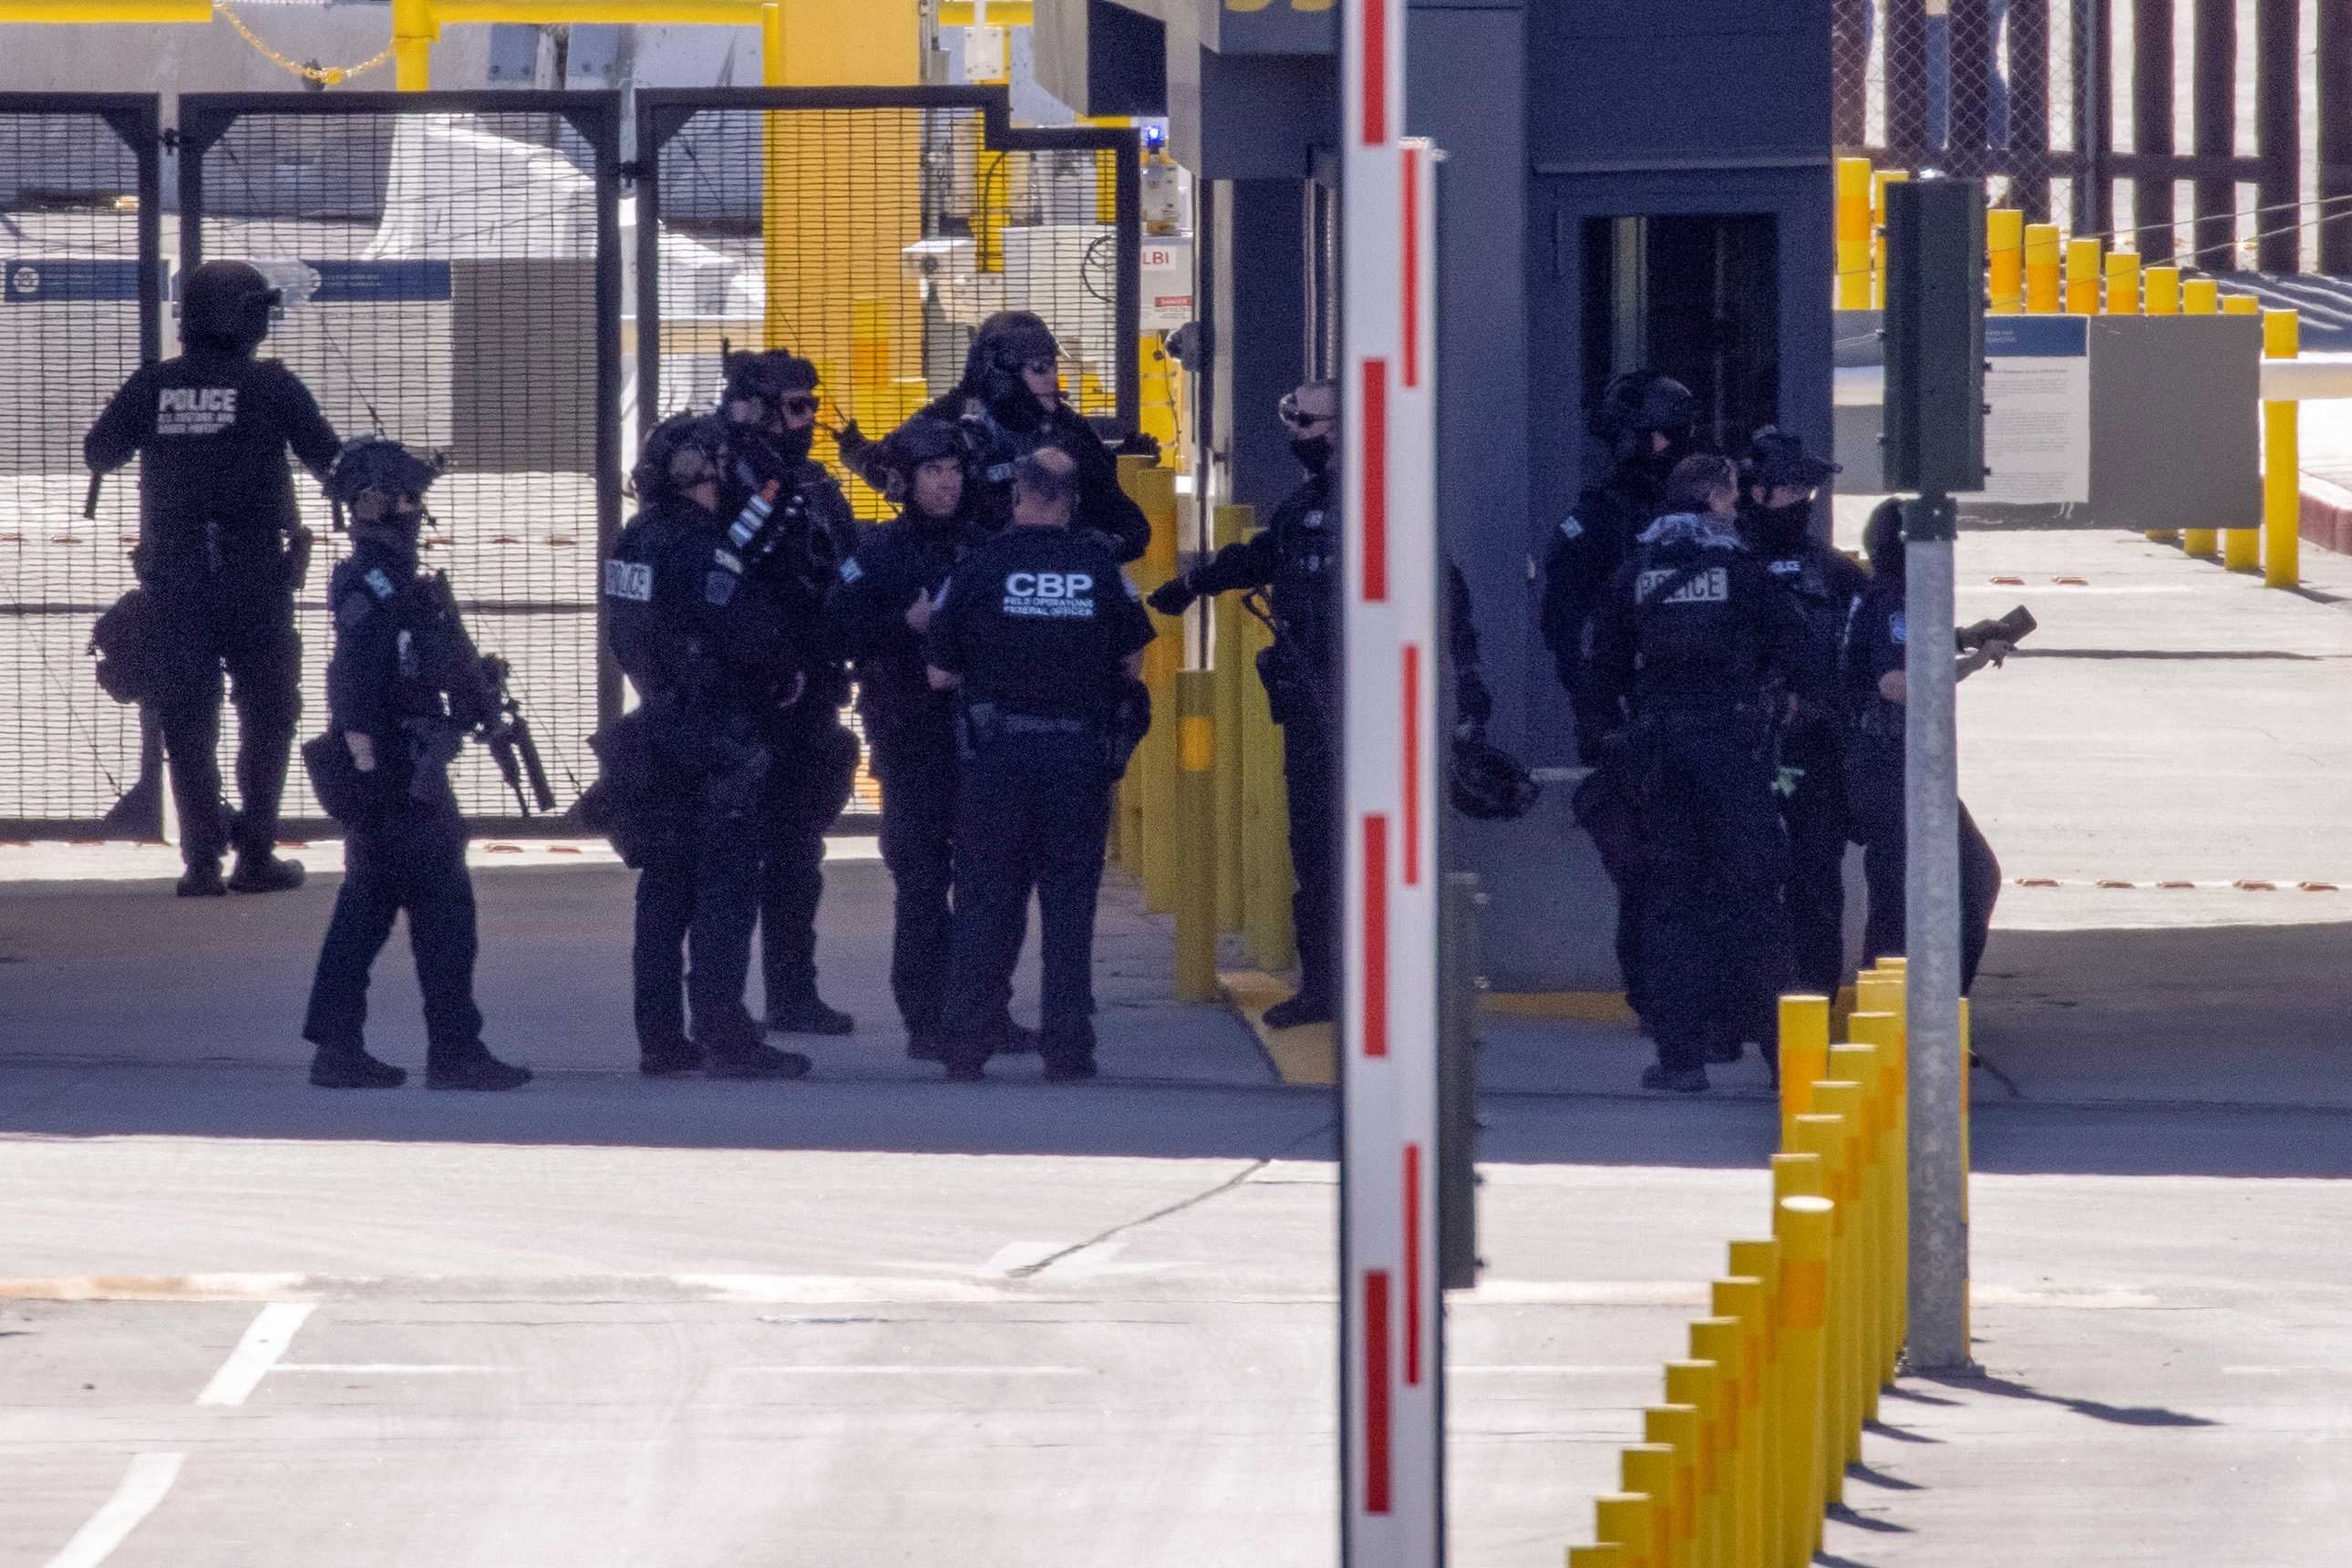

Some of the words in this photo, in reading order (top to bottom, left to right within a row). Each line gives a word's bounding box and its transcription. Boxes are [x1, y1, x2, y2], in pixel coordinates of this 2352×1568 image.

[1142, 251, 1170, 265] LBI
[159, 388, 237, 412] POLICE
[1006, 573, 1093, 598] CBP
